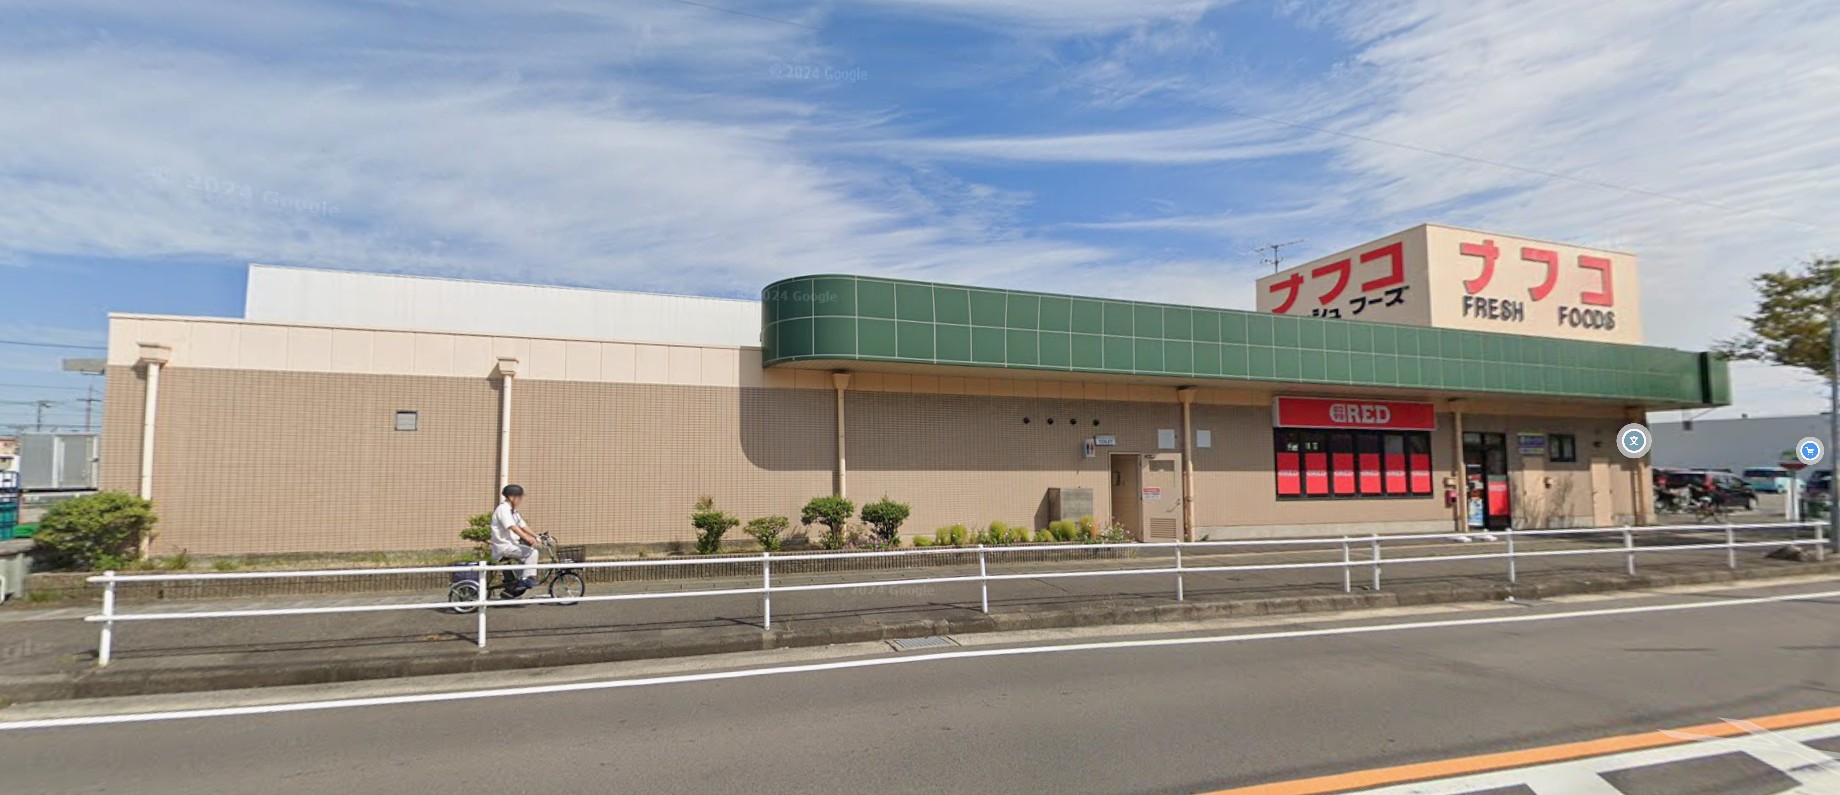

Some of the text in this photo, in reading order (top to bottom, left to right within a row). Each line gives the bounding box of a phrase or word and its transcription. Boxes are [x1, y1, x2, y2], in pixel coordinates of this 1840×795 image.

[1269, 241, 1404, 315] ナフコ
[1459, 239, 1615, 307] ナフコ
[1349, 285, 1410, 315] フーズ
[1461, 295, 1616, 331] FRESH FOODS
